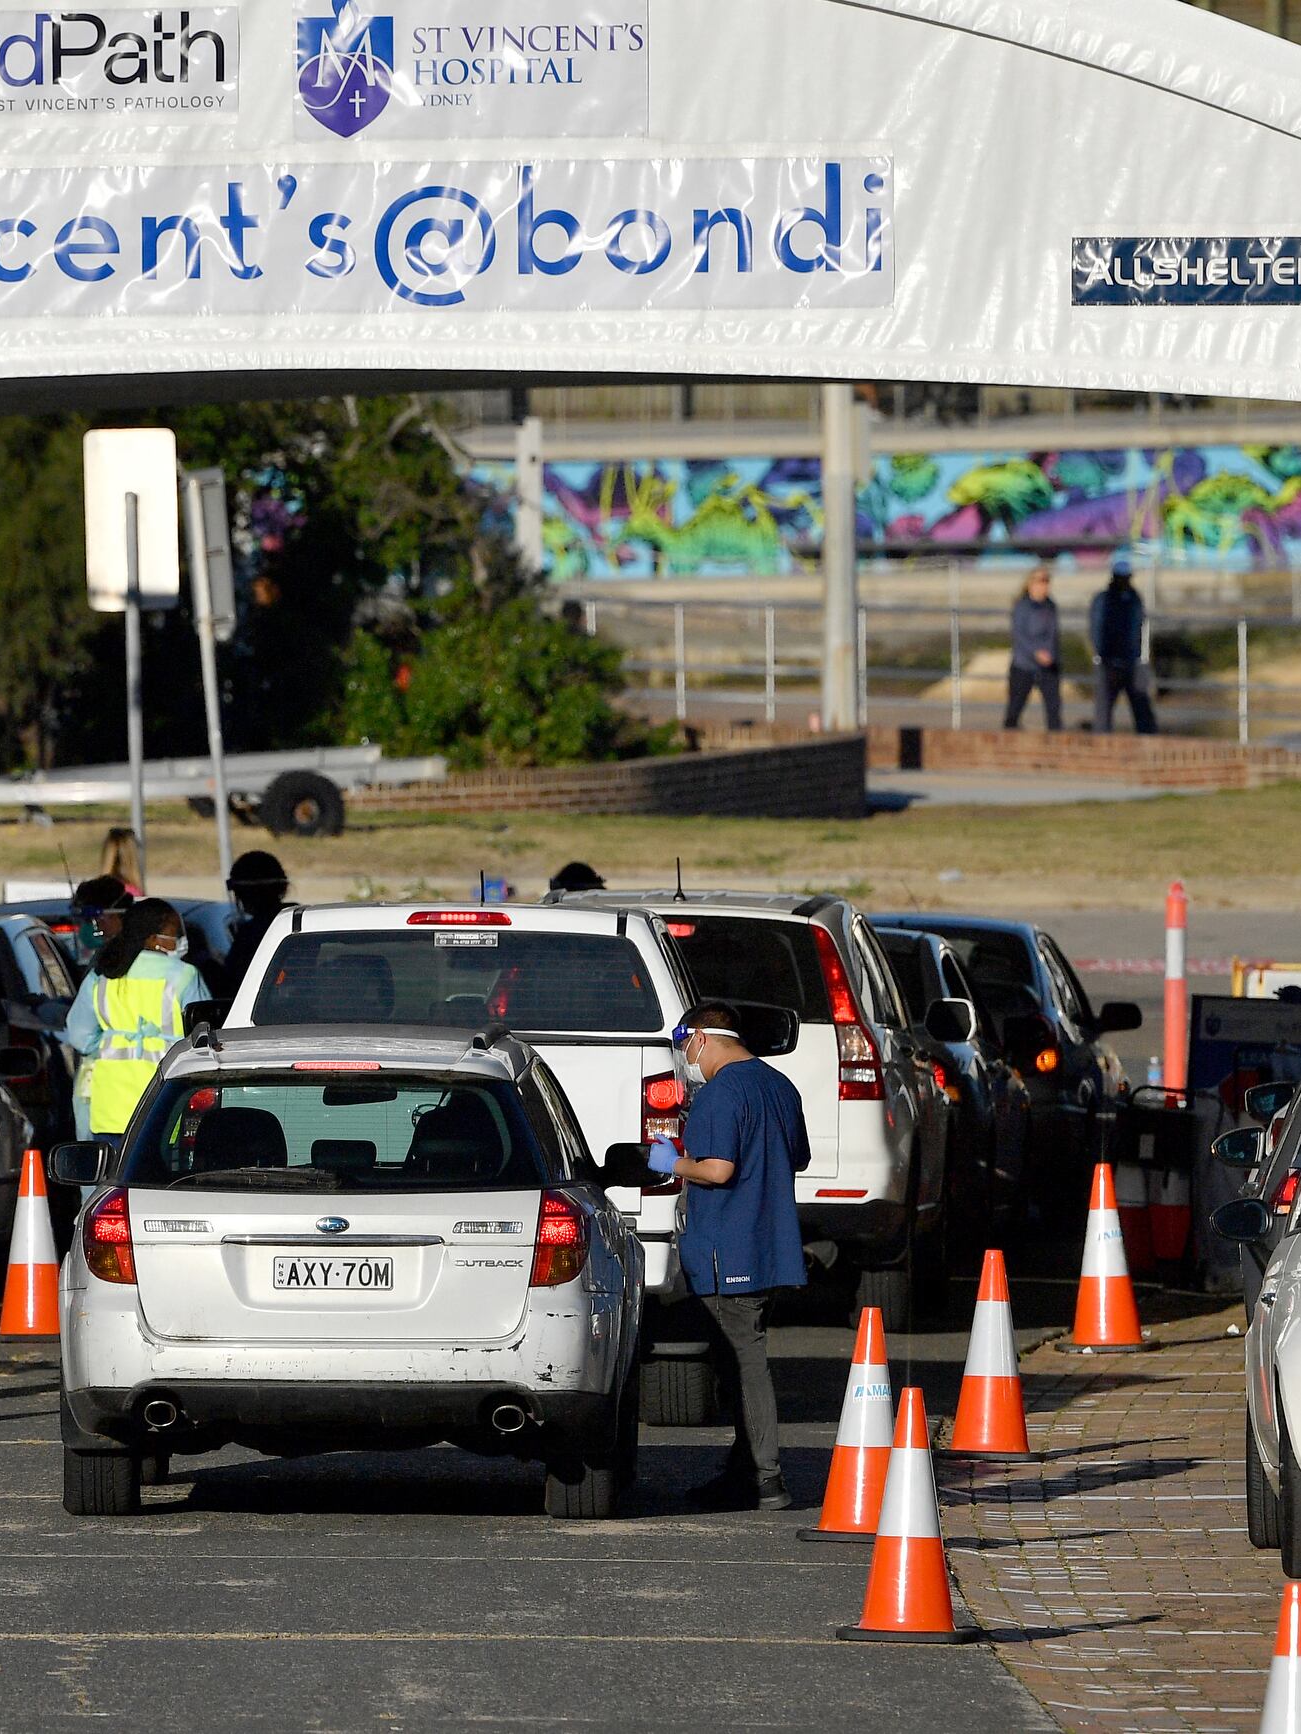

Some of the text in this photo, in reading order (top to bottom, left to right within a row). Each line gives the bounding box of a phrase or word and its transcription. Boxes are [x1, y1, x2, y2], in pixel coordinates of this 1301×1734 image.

[412, 23, 643, 54] ST VINCENT'S
[414, 57, 583, 86] HOSPITAL
[24, 97, 116, 112] VINCENT'S
[124, 95, 226, 110] PATHOLOGY
[421, 93, 473, 107] YDNEY
[1085, 257, 1301, 286] ALLSHELTE
[455, 1259, 523, 1268] OUTBACK
